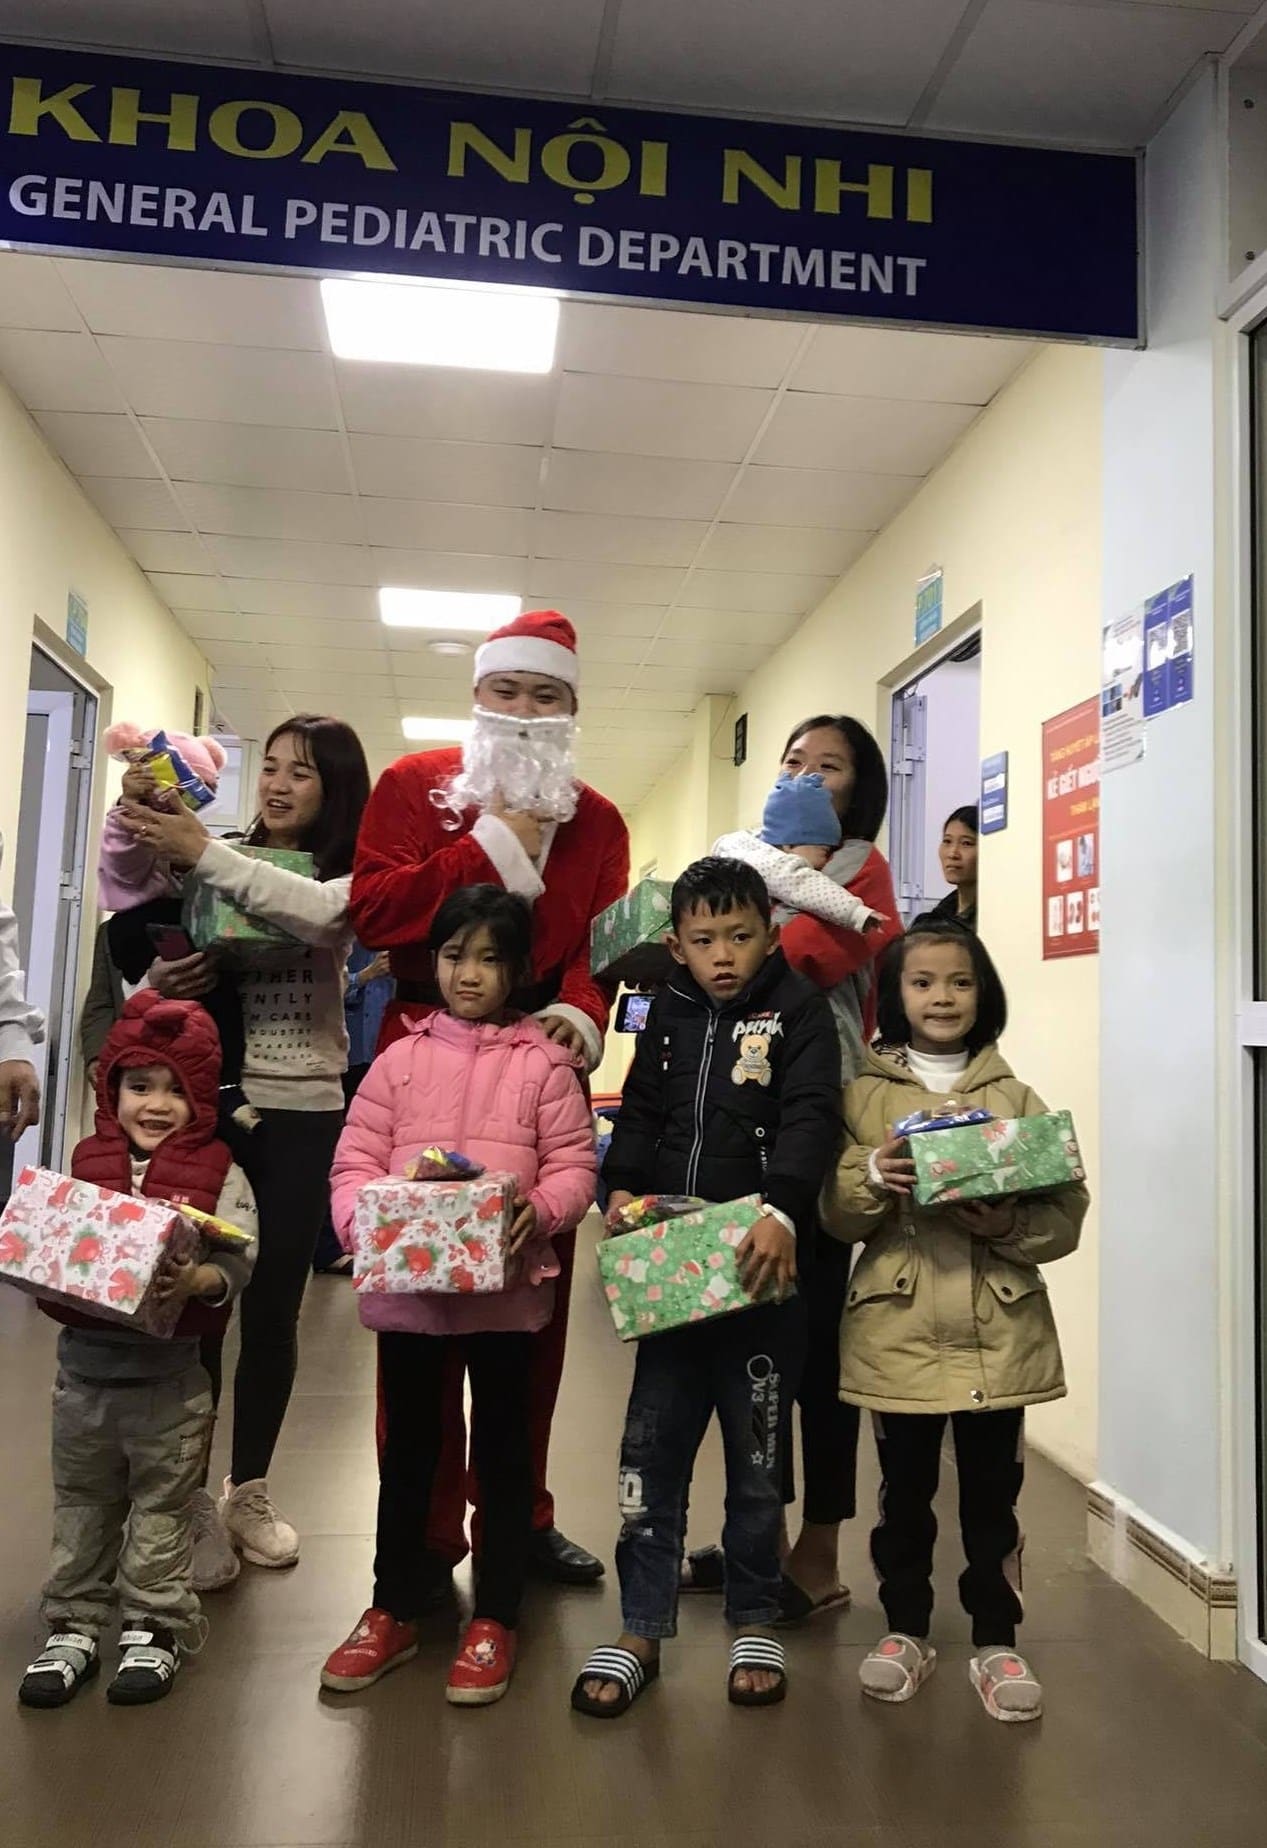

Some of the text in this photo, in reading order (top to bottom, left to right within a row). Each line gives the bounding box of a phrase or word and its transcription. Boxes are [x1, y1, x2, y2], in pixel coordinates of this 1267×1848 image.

[8, 76, 933, 223] KHOA NỘI NHI
[8, 174, 927, 297] GENERAL PEDIATRIC DEPARTMENT
